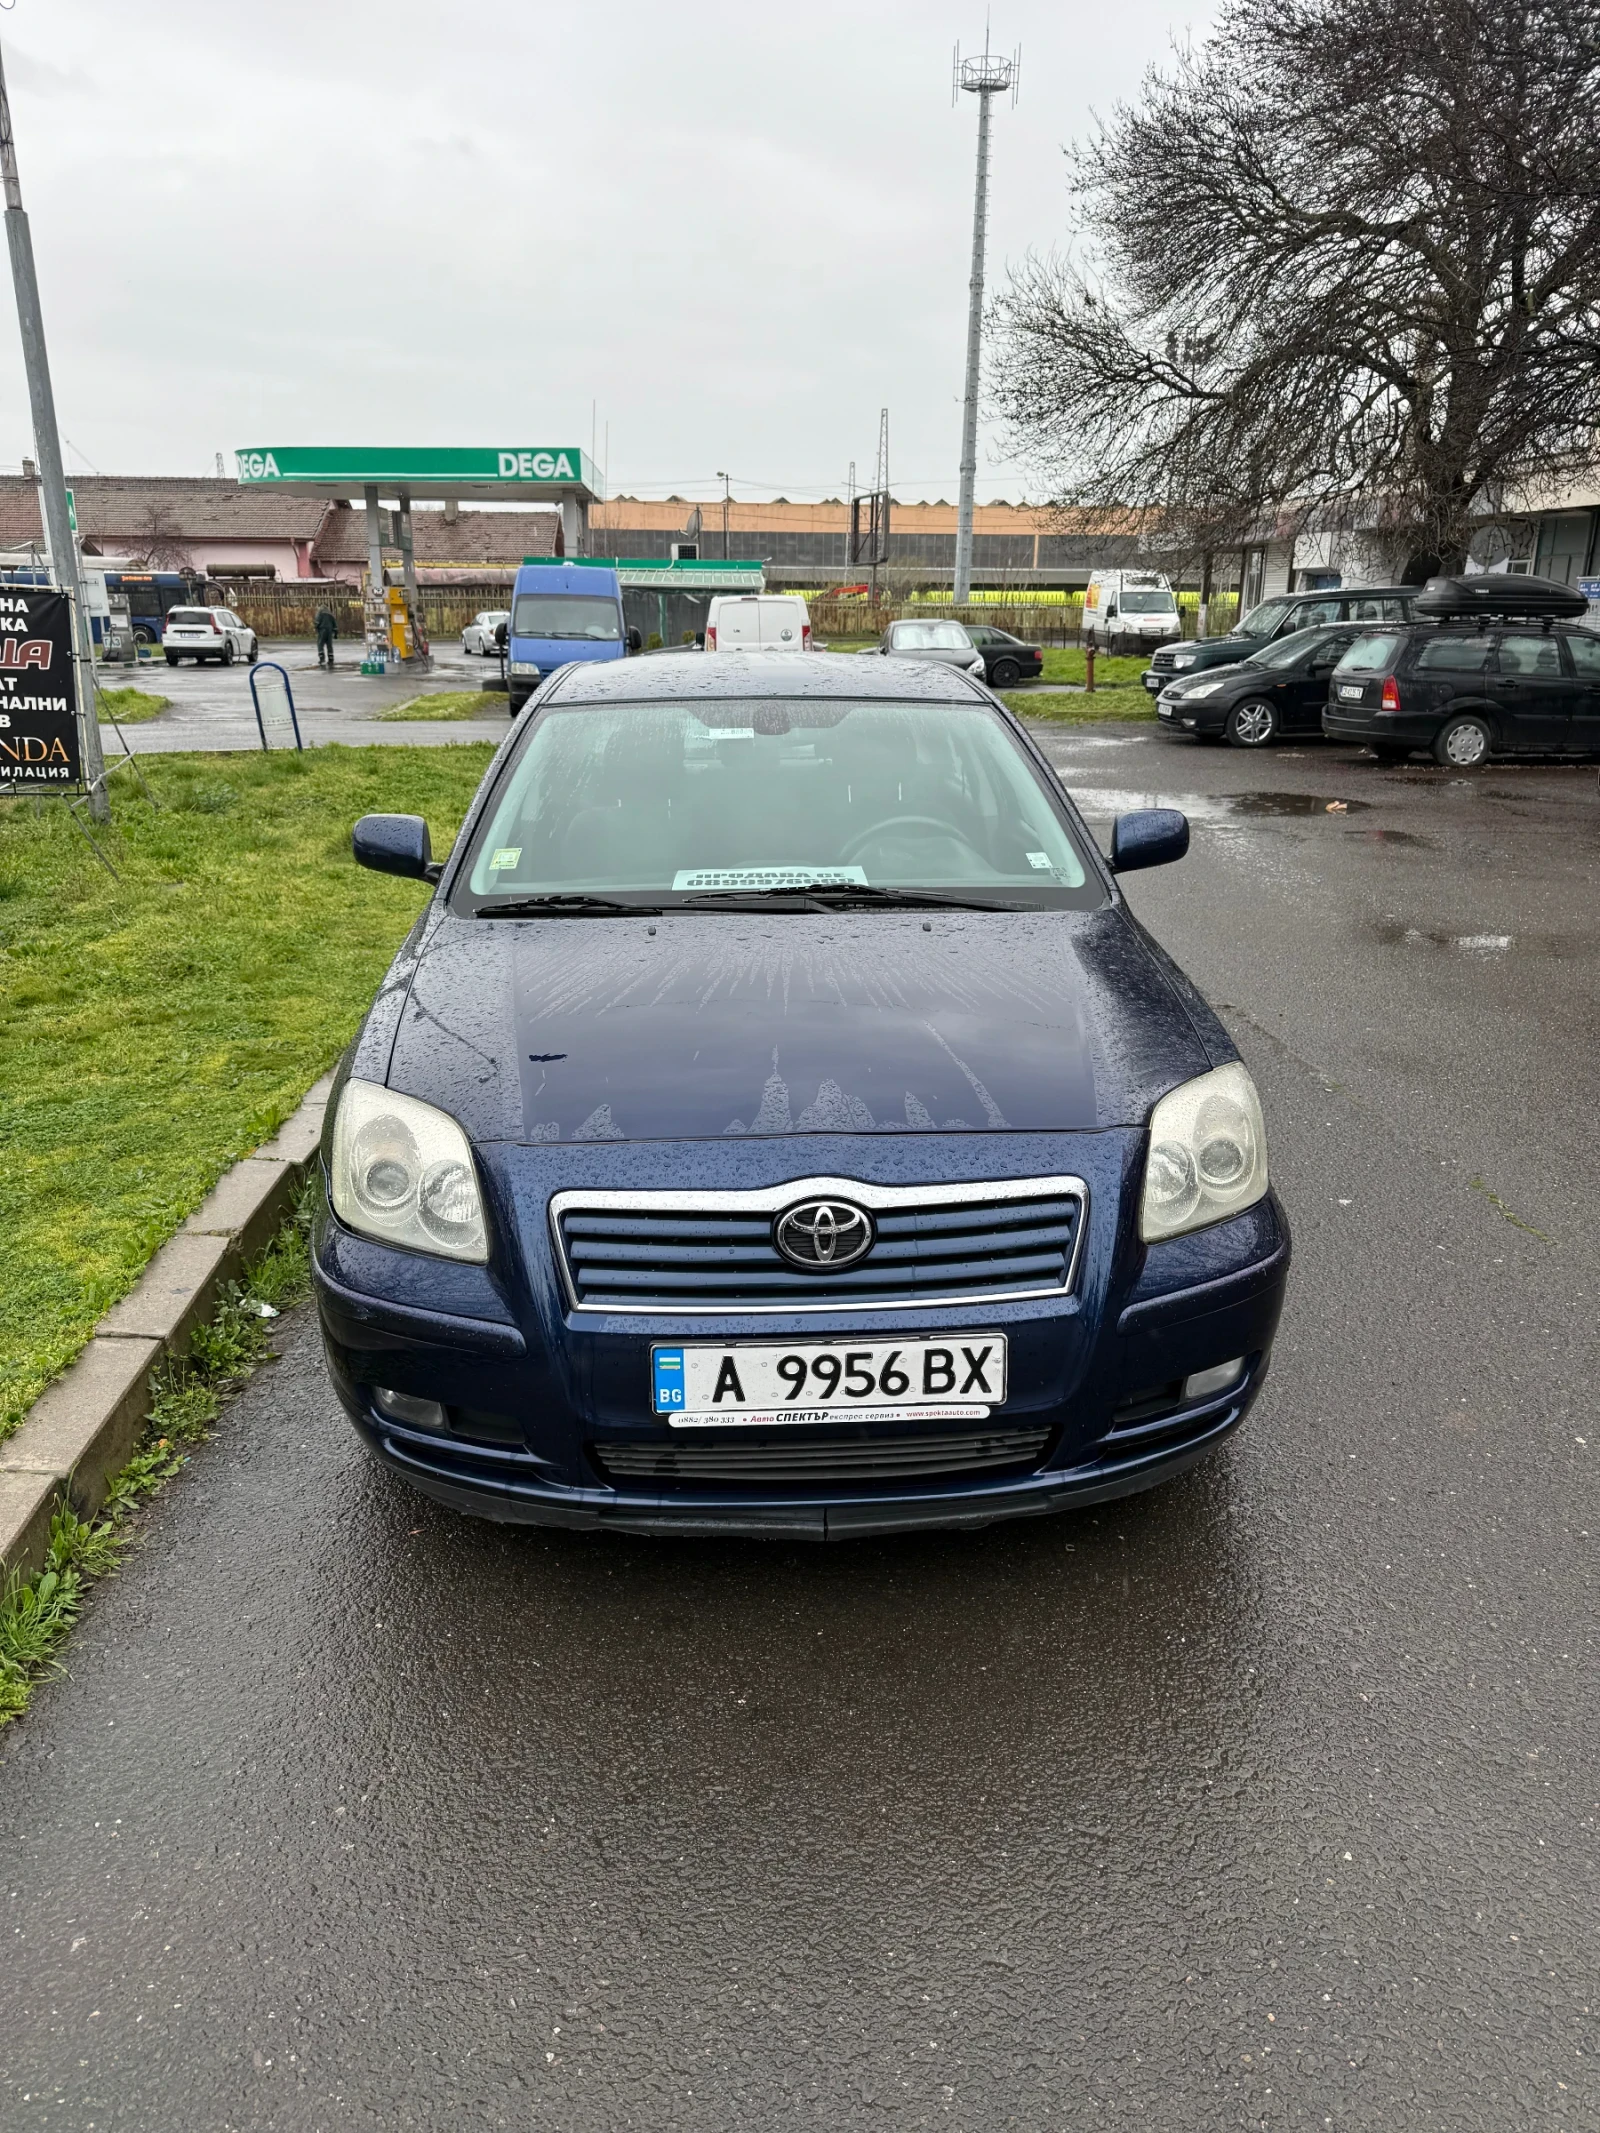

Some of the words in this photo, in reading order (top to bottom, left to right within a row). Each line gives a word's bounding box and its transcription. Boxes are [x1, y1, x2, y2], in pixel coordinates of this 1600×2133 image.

[236, 453, 281, 478] DEGA
[498, 452, 575, 478] DEGA
[712, 1355, 746, 1402] A
[777, 1350, 910, 1400] 9956
[922, 1346, 993, 1395] BX
[659, 1388, 682, 1403] BG
[703, 1416, 719, 1424] 380
[720, 1416, 735, 1424] 333
[750, 1414, 775, 1422] Авто
[776, 1411, 830, 1422] СПЕКТЪР
[829, 1413, 863, 1422] експрес
[865, 1411, 894, 1421] сервиз
